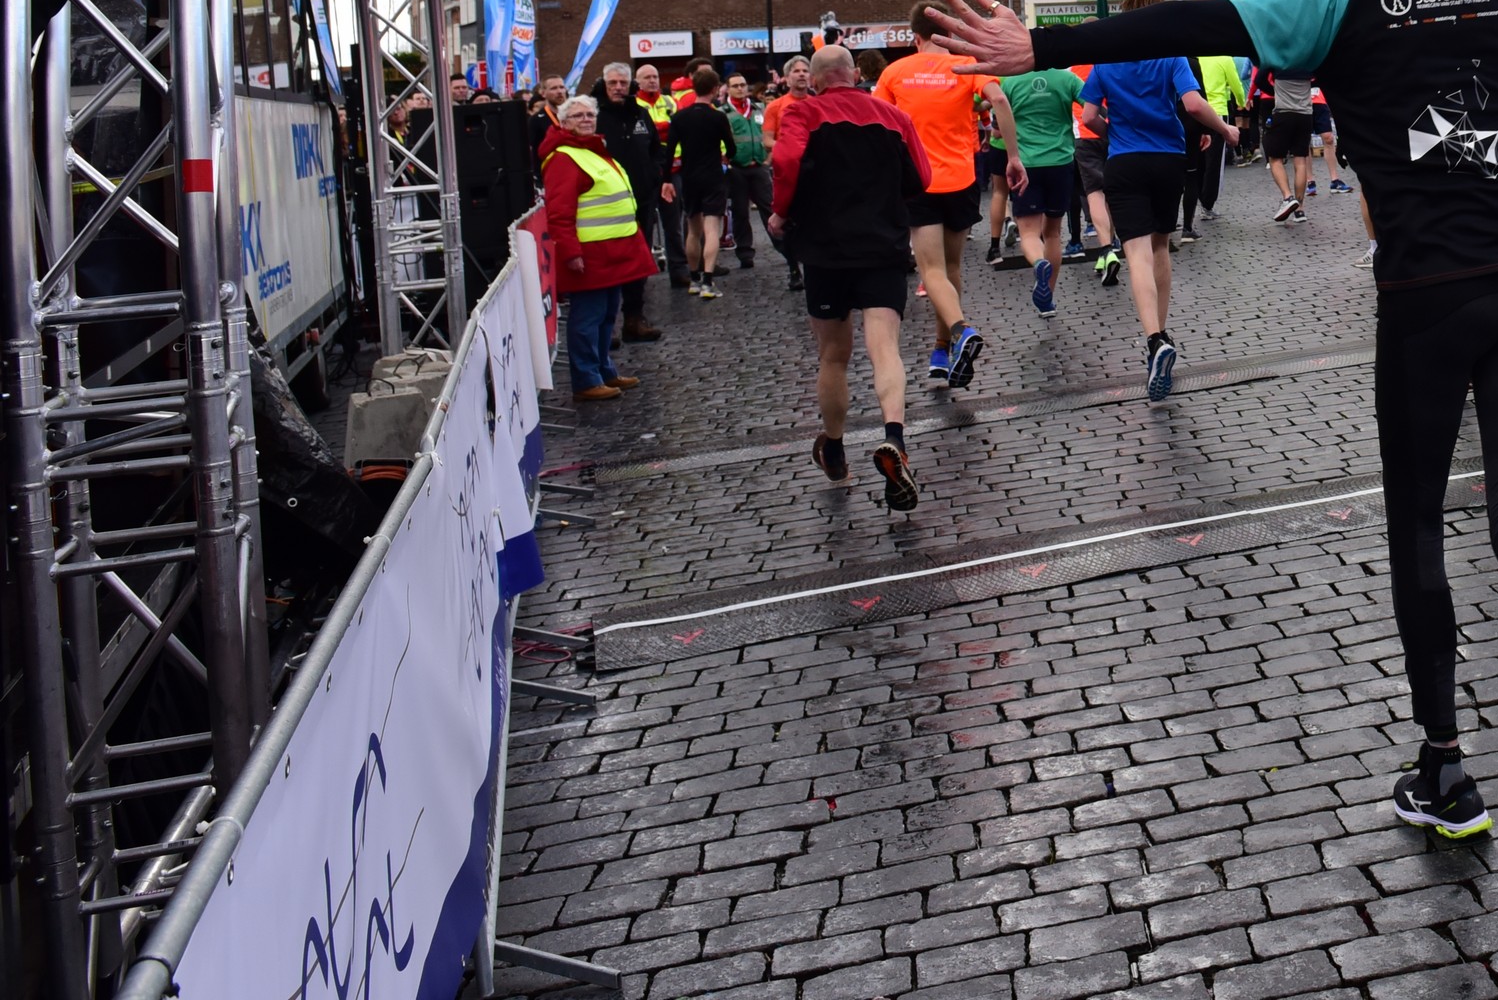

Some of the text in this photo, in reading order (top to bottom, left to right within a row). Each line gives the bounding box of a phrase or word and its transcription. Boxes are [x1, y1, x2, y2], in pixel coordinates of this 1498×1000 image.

[1040, 6, 1079, 14] FALAFEL
[1042, 16, 1060, 25] With
[880, 29, 915, 43] €365
